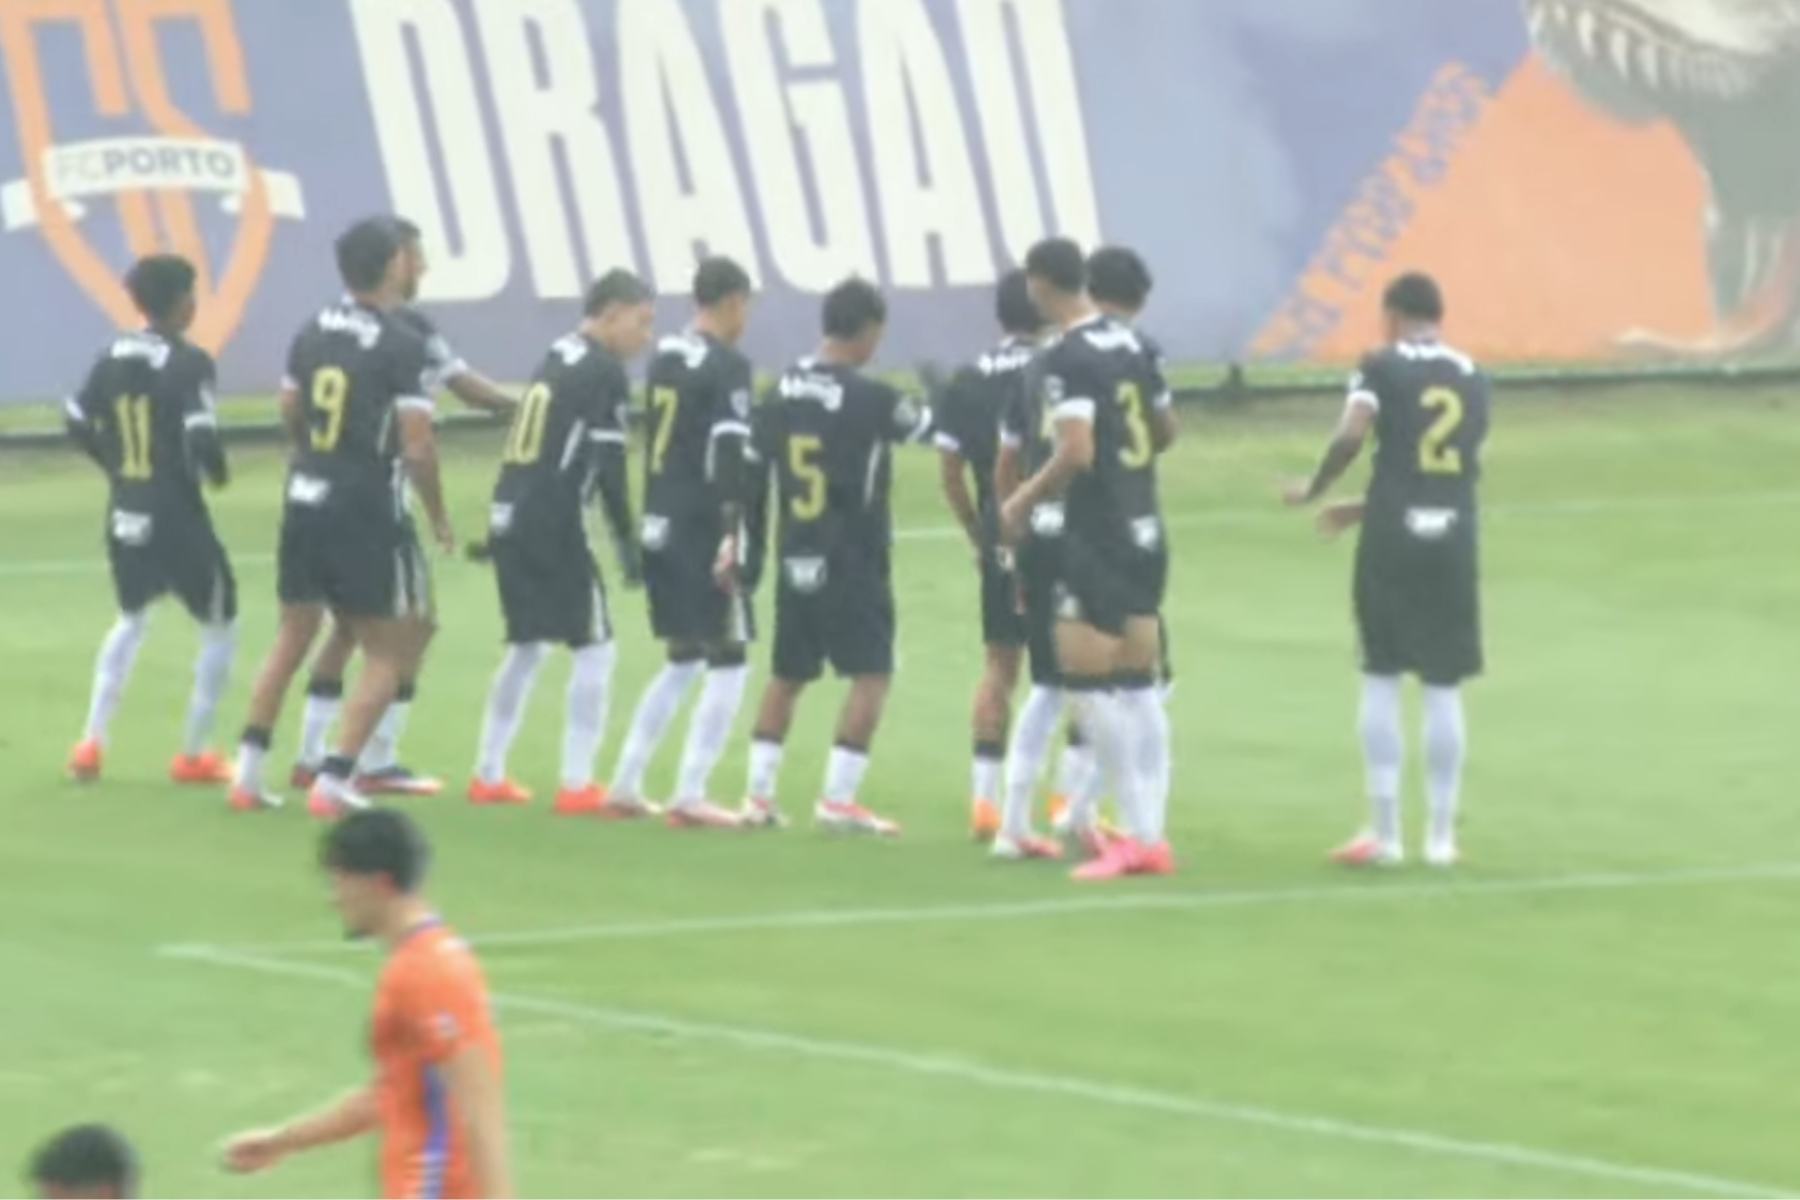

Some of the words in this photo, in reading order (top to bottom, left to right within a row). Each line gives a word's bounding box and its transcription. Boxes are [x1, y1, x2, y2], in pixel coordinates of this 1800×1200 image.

[115, 394, 152, 479] 11
[311, 365, 348, 453] 9
[653, 386, 678, 475] 7
[1117, 379, 1152, 469] 3
[1420, 385, 1463, 473] 2
[788, 433, 827, 521] 5
